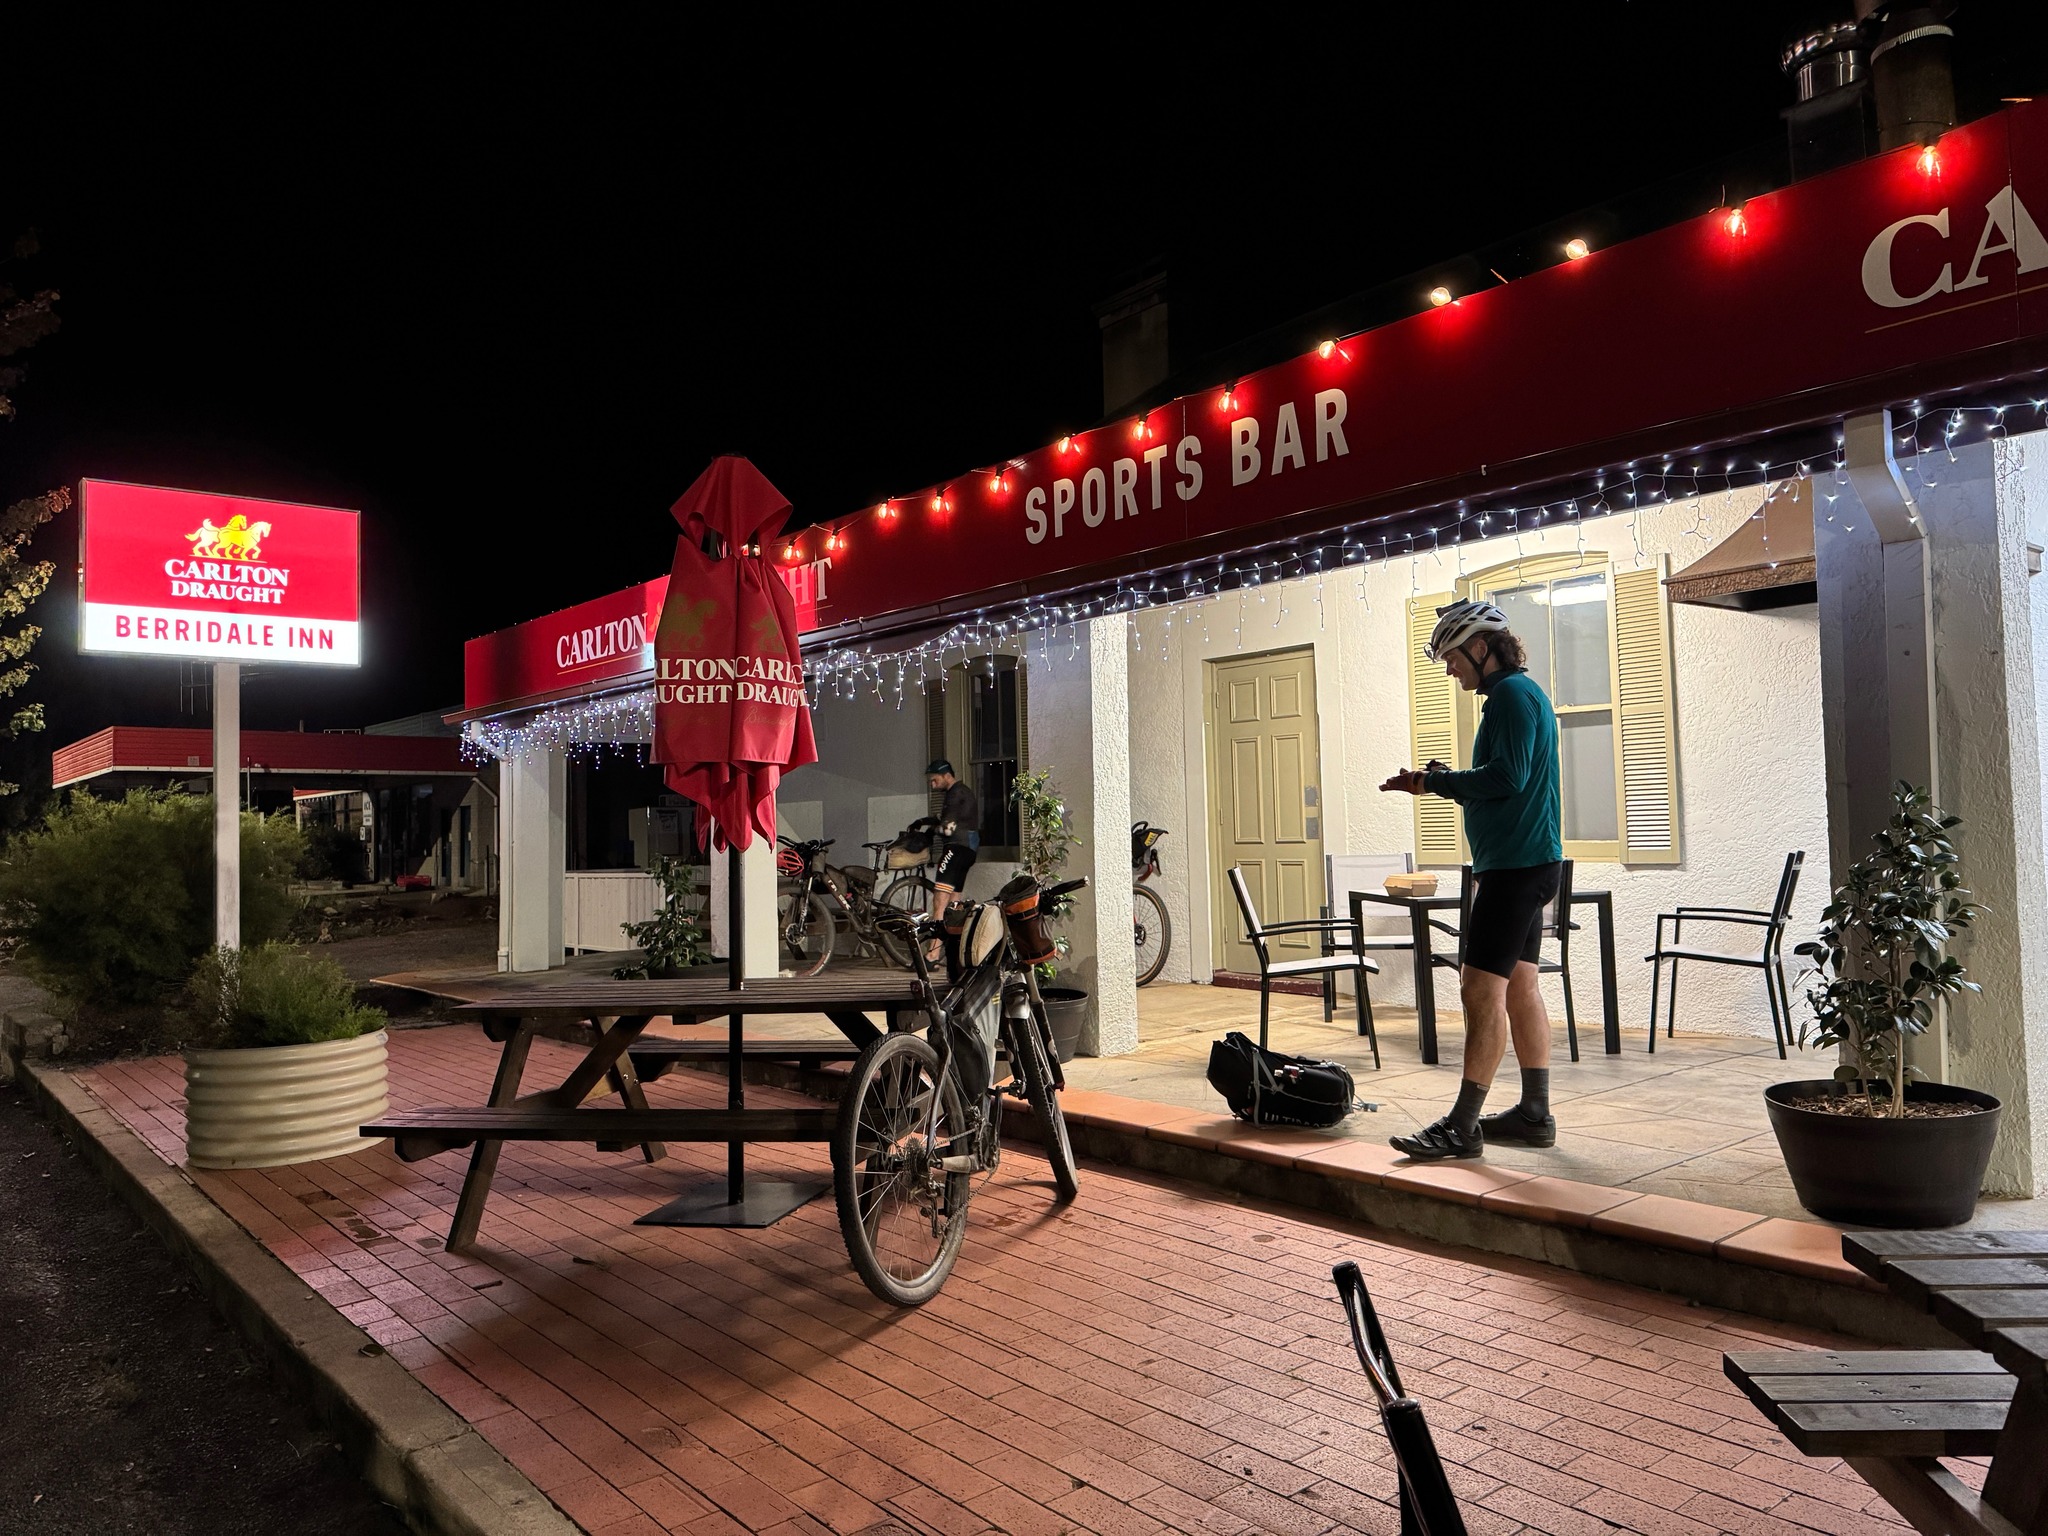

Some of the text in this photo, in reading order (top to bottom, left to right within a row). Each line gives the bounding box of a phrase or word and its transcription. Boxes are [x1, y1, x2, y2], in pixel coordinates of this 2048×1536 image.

[1025, 388, 1350, 544] SPORTS BAR
[164, 558, 290, 587] CARLTON
[171, 580, 285, 604] DRAUGHT
[116, 615, 333, 650] BERRIDALE INN
[556, 612, 648, 668] CARLTON
